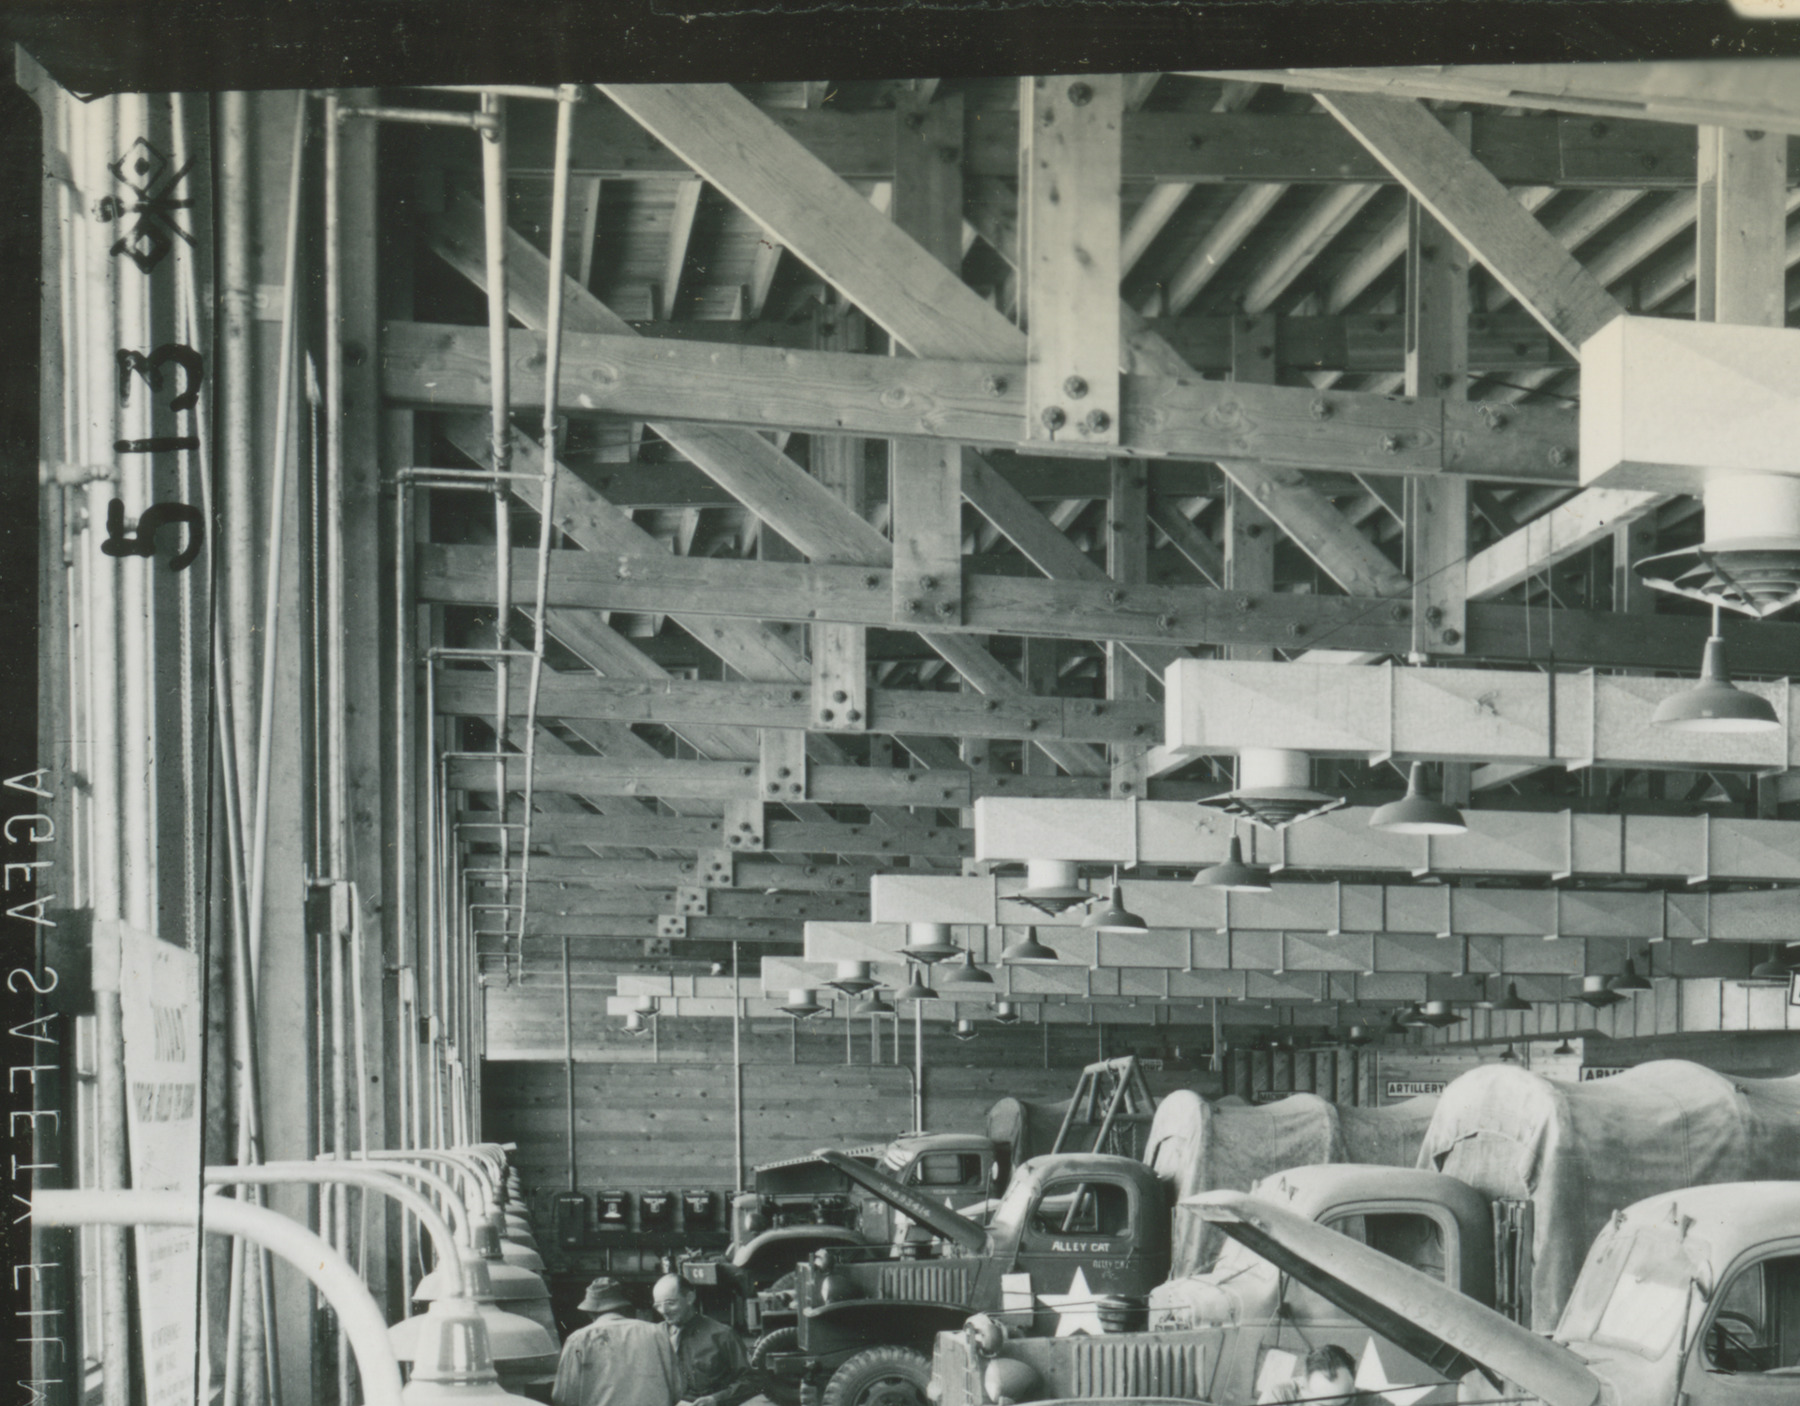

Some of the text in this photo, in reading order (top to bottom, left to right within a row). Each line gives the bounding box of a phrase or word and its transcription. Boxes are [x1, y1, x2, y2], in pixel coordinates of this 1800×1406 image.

[1389, 1083, 1445, 1094] ARTILLERY
[1051, 1241, 1111, 1252] ALLEY CAT
